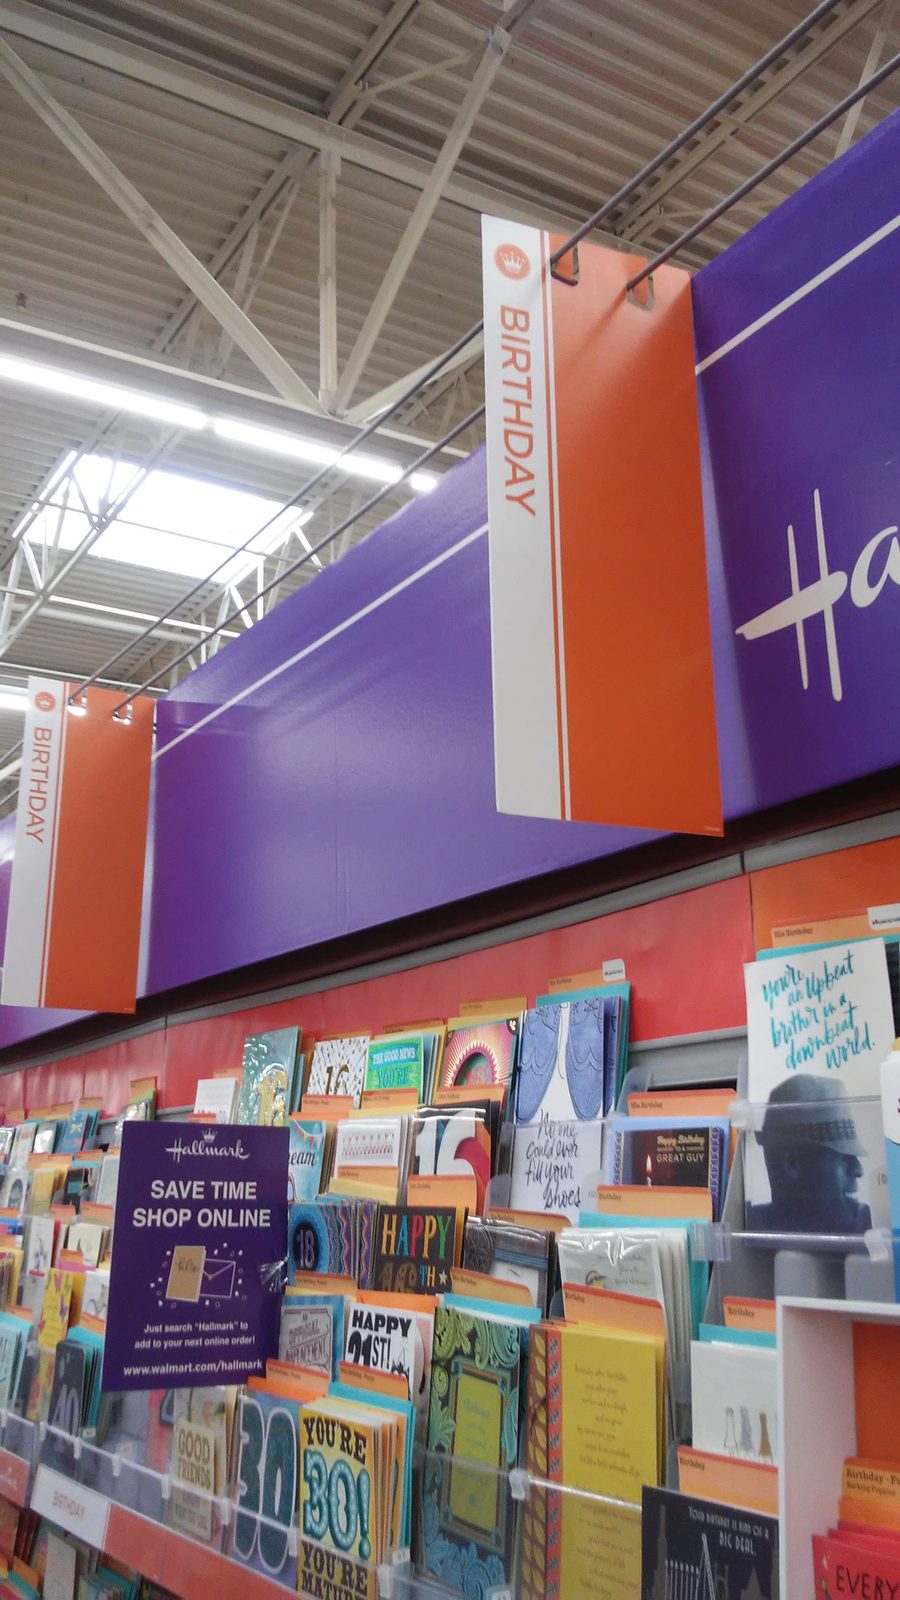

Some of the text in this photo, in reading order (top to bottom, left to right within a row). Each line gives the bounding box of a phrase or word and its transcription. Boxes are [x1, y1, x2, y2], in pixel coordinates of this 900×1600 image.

[499, 304, 536, 517] BIRTHDAY
[26, 727, 53, 844] BIRTHDAY
[770, 1005, 820, 1048] brother
[785, 1000, 858, 1070] downbeat
[384, 1048, 399, 1062] GOOD
[165, 1137, 250, 1164] Hallmark
[288, 1151, 316, 1167] eam
[656, 1152, 705, 1163] GREAT GUY
[151, 1179, 257, 1201] SAVE TIME
[132, 1207, 271, 1228] SHOP ONLINE
[295, 1229, 315, 1269] 18
[380, 1213, 452, 1260] HAPPY
[351, 1309, 413, 1338] HAPPY
[727, 1306, 755, 1319] Birthday
[144, 1323, 163, 1334] Just
[164, 1322, 193, 1333] search
[240, 1321, 249, 1331] to
[134, 1335, 256, 1350] add to your next online order!
[123, 1358, 263, 1377] www.walmart.com/hallmark
[178, 1428, 210, 1466] GOOD
[303, 1415, 367, 1466] YOU'RE
[177, 1457, 211, 1491] FRIENDS
[846, 1466, 883, 1485] Birthday
[52, 1489, 86, 1520] BIRTHDAY
[303, 1449, 372, 1561] 30!
[719, 1529, 732, 1549] BIG
[301, 1539, 368, 1598] YOU'RE
